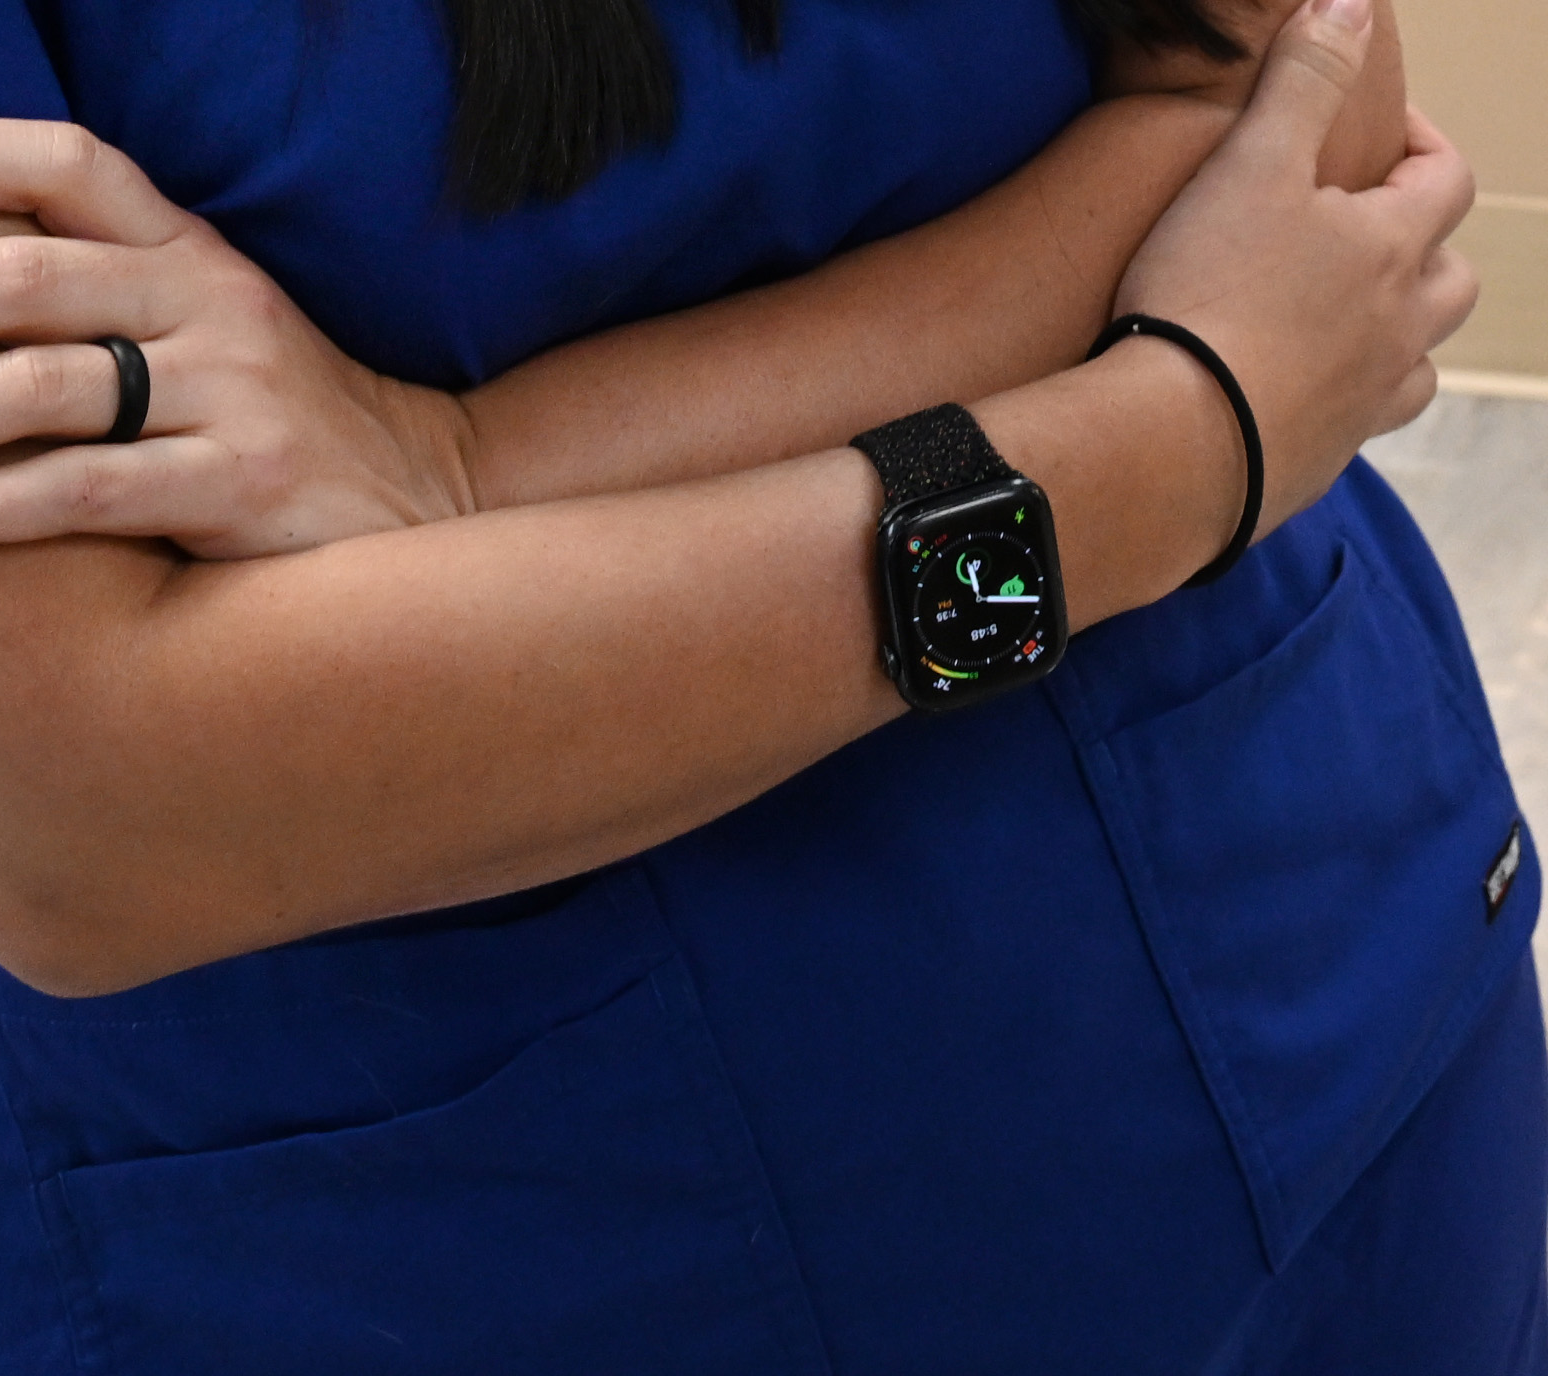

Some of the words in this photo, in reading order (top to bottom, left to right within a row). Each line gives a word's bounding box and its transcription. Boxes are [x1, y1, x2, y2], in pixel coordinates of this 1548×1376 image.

[938, 598, 953, 610] PM
[970, 623, 998, 642] 5:48
[1026, 644, 1045, 664] TUE
